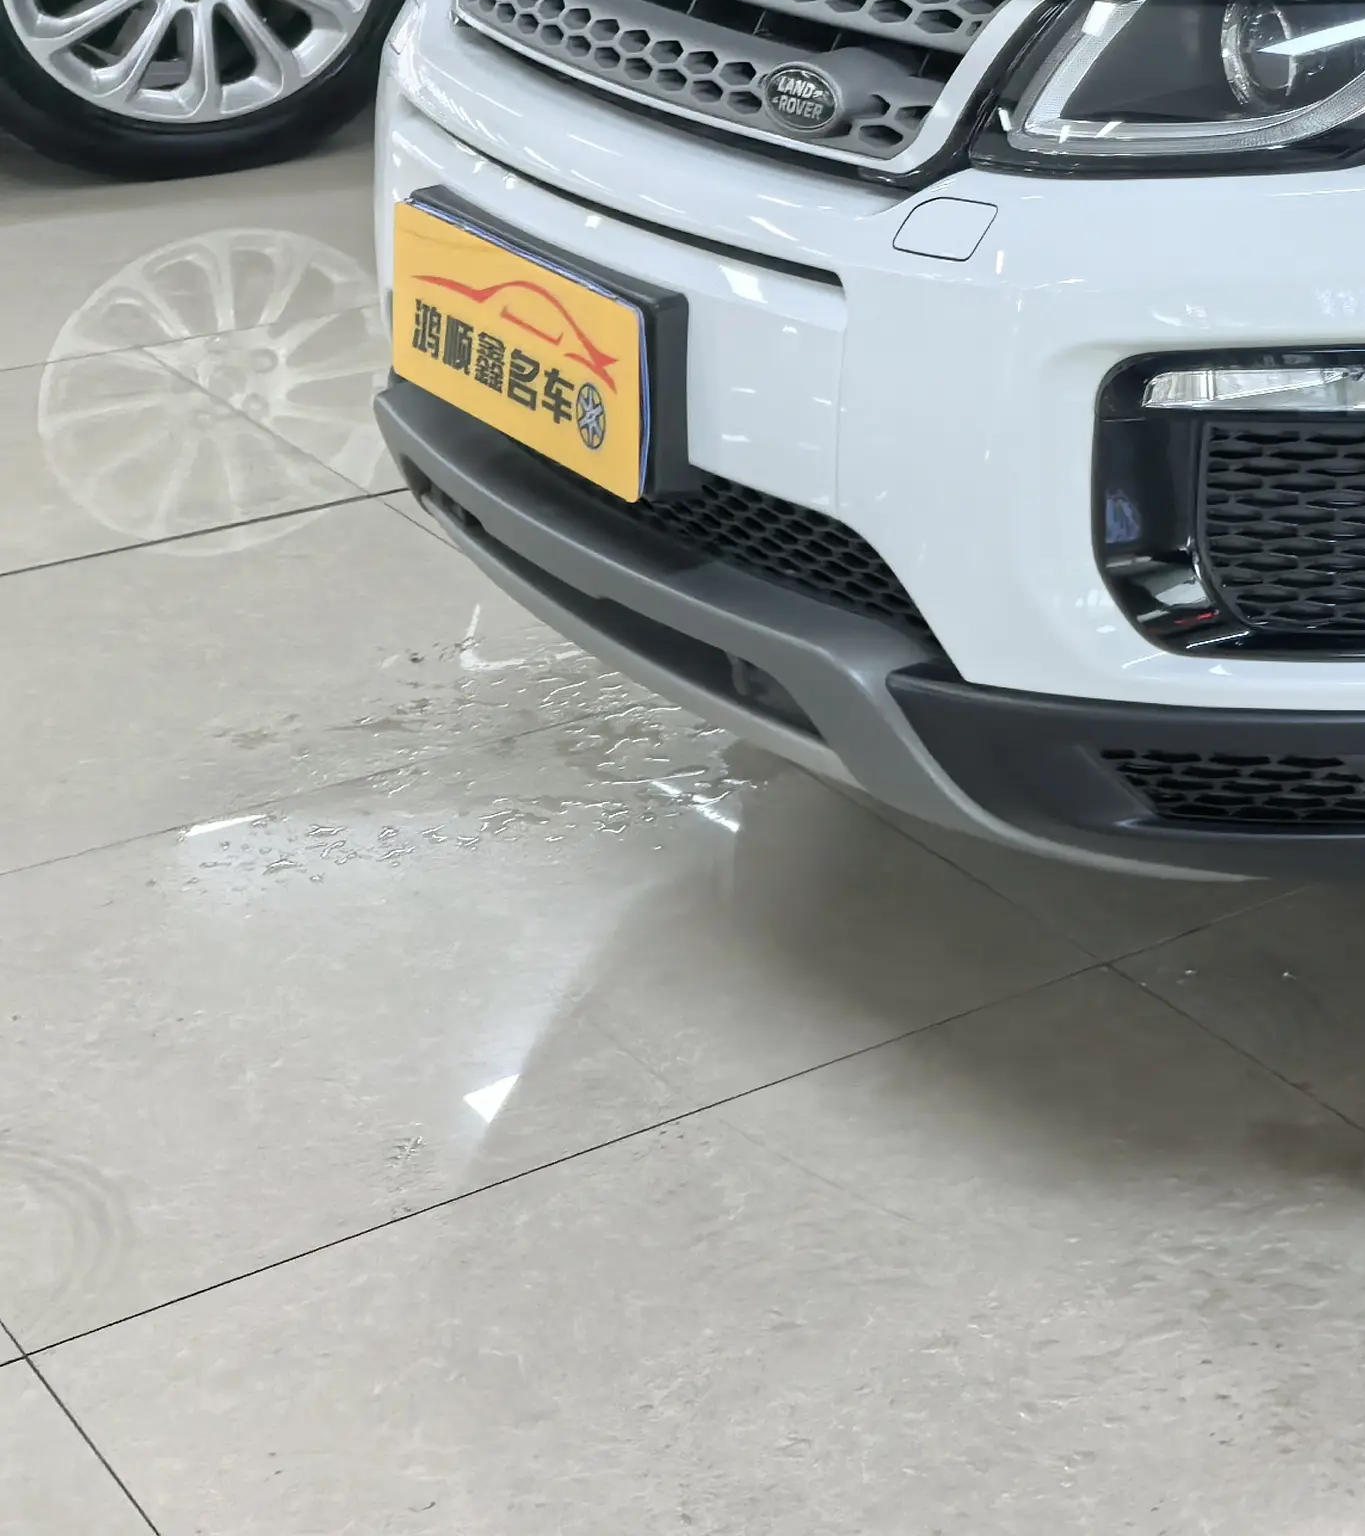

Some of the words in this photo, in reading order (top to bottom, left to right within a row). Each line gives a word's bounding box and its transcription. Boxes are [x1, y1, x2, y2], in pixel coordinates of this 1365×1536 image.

[777, 75, 816, 99] LAND
[778, 94, 824, 121] ROVER
[411, 298, 576, 425] 鸿顺鑫名车
